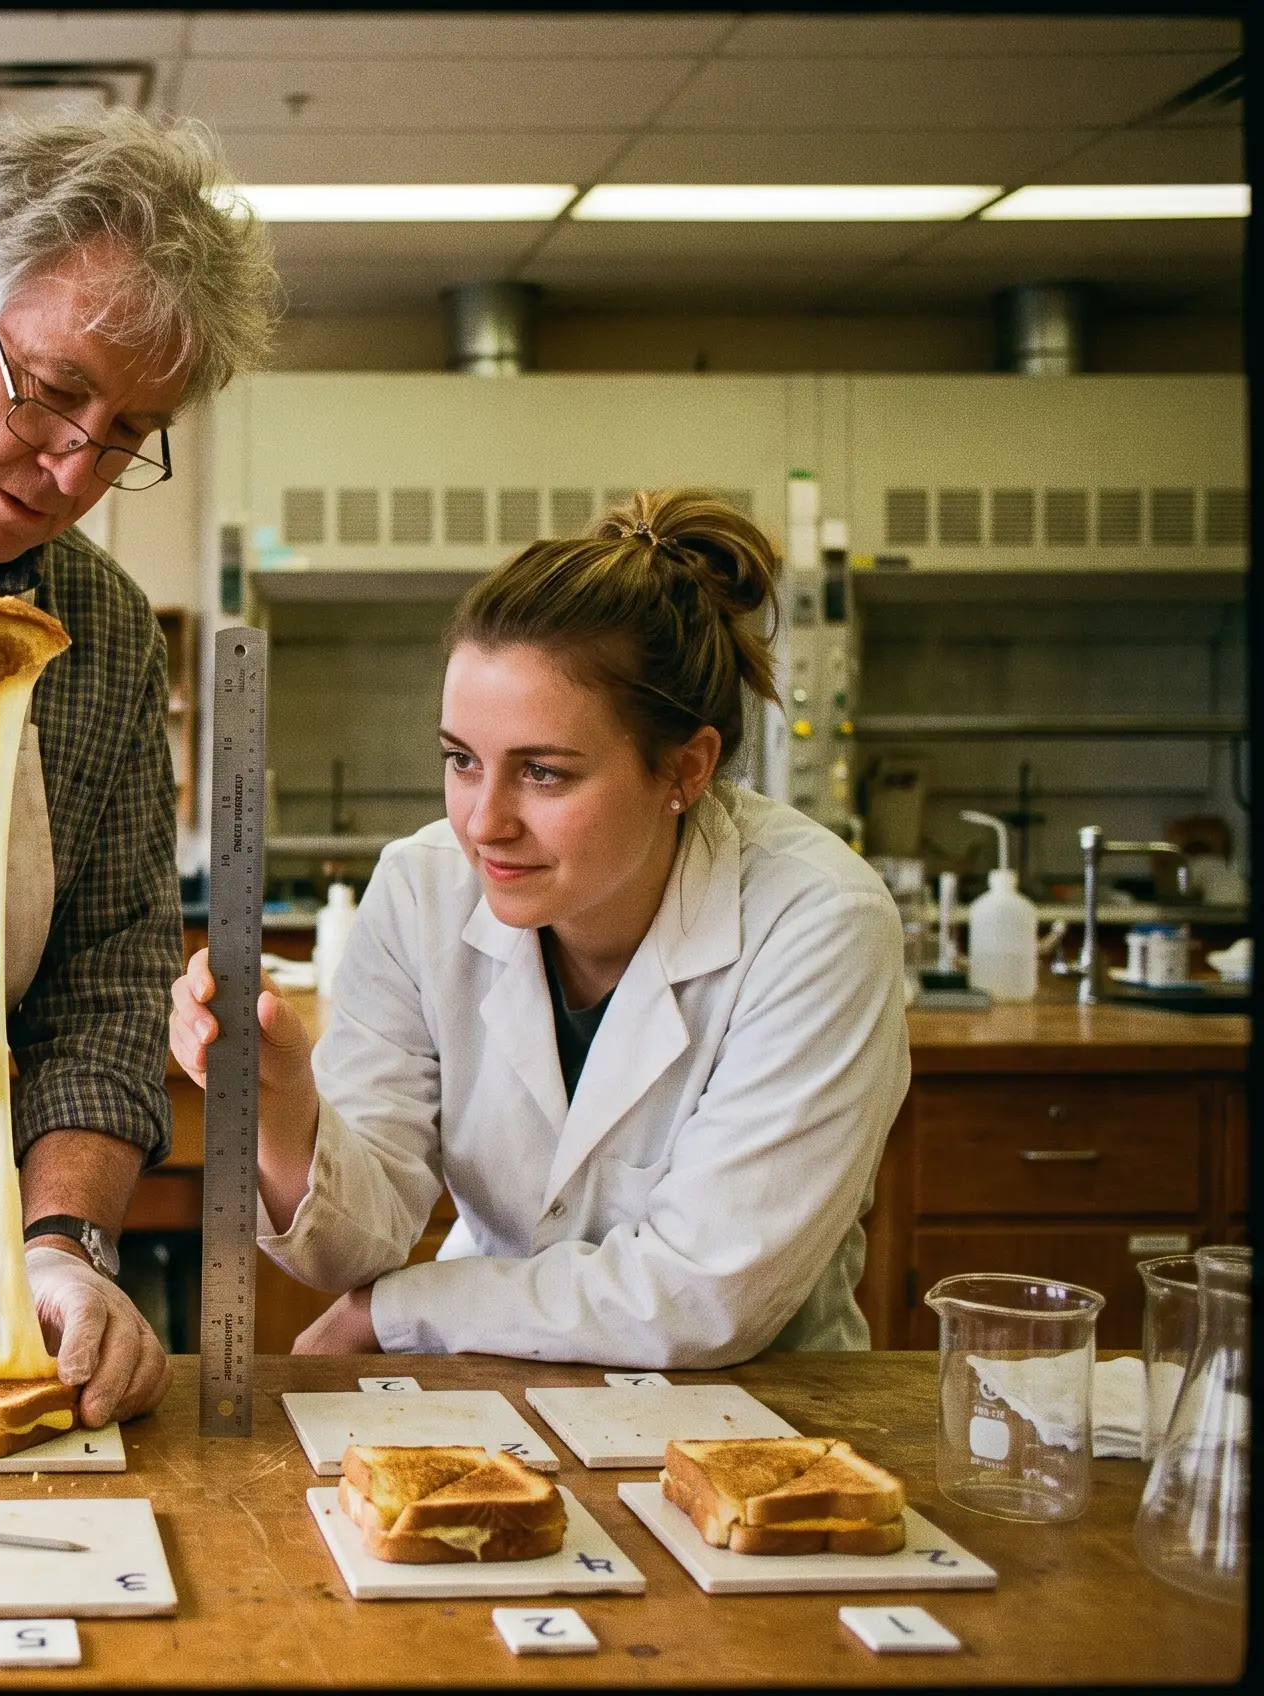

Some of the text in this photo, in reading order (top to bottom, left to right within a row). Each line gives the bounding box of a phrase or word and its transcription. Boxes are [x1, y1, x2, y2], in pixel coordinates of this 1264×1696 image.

[915, 1549, 958, 1567] 2
[116, 1573, 147, 1591] 3
[522, 1617, 566, 1637] 2
[16, 1627, 47, 1649] 5
